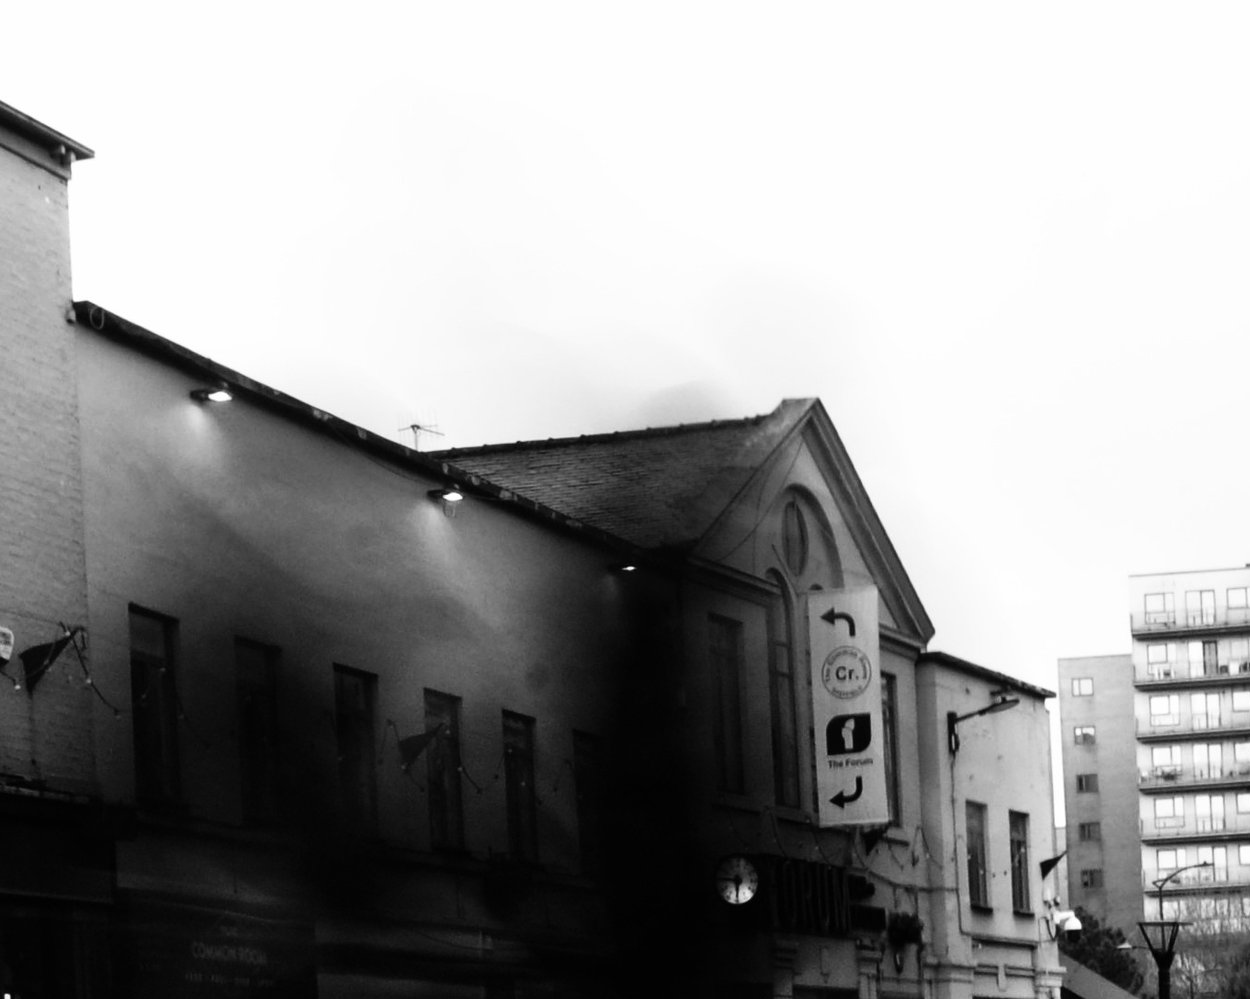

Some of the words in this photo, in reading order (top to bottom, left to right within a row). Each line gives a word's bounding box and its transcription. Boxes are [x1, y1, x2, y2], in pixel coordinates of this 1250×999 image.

[835, 665, 859, 681] Cr.
[828, 759, 844, 769] The
[845, 757, 874, 767] Forum
